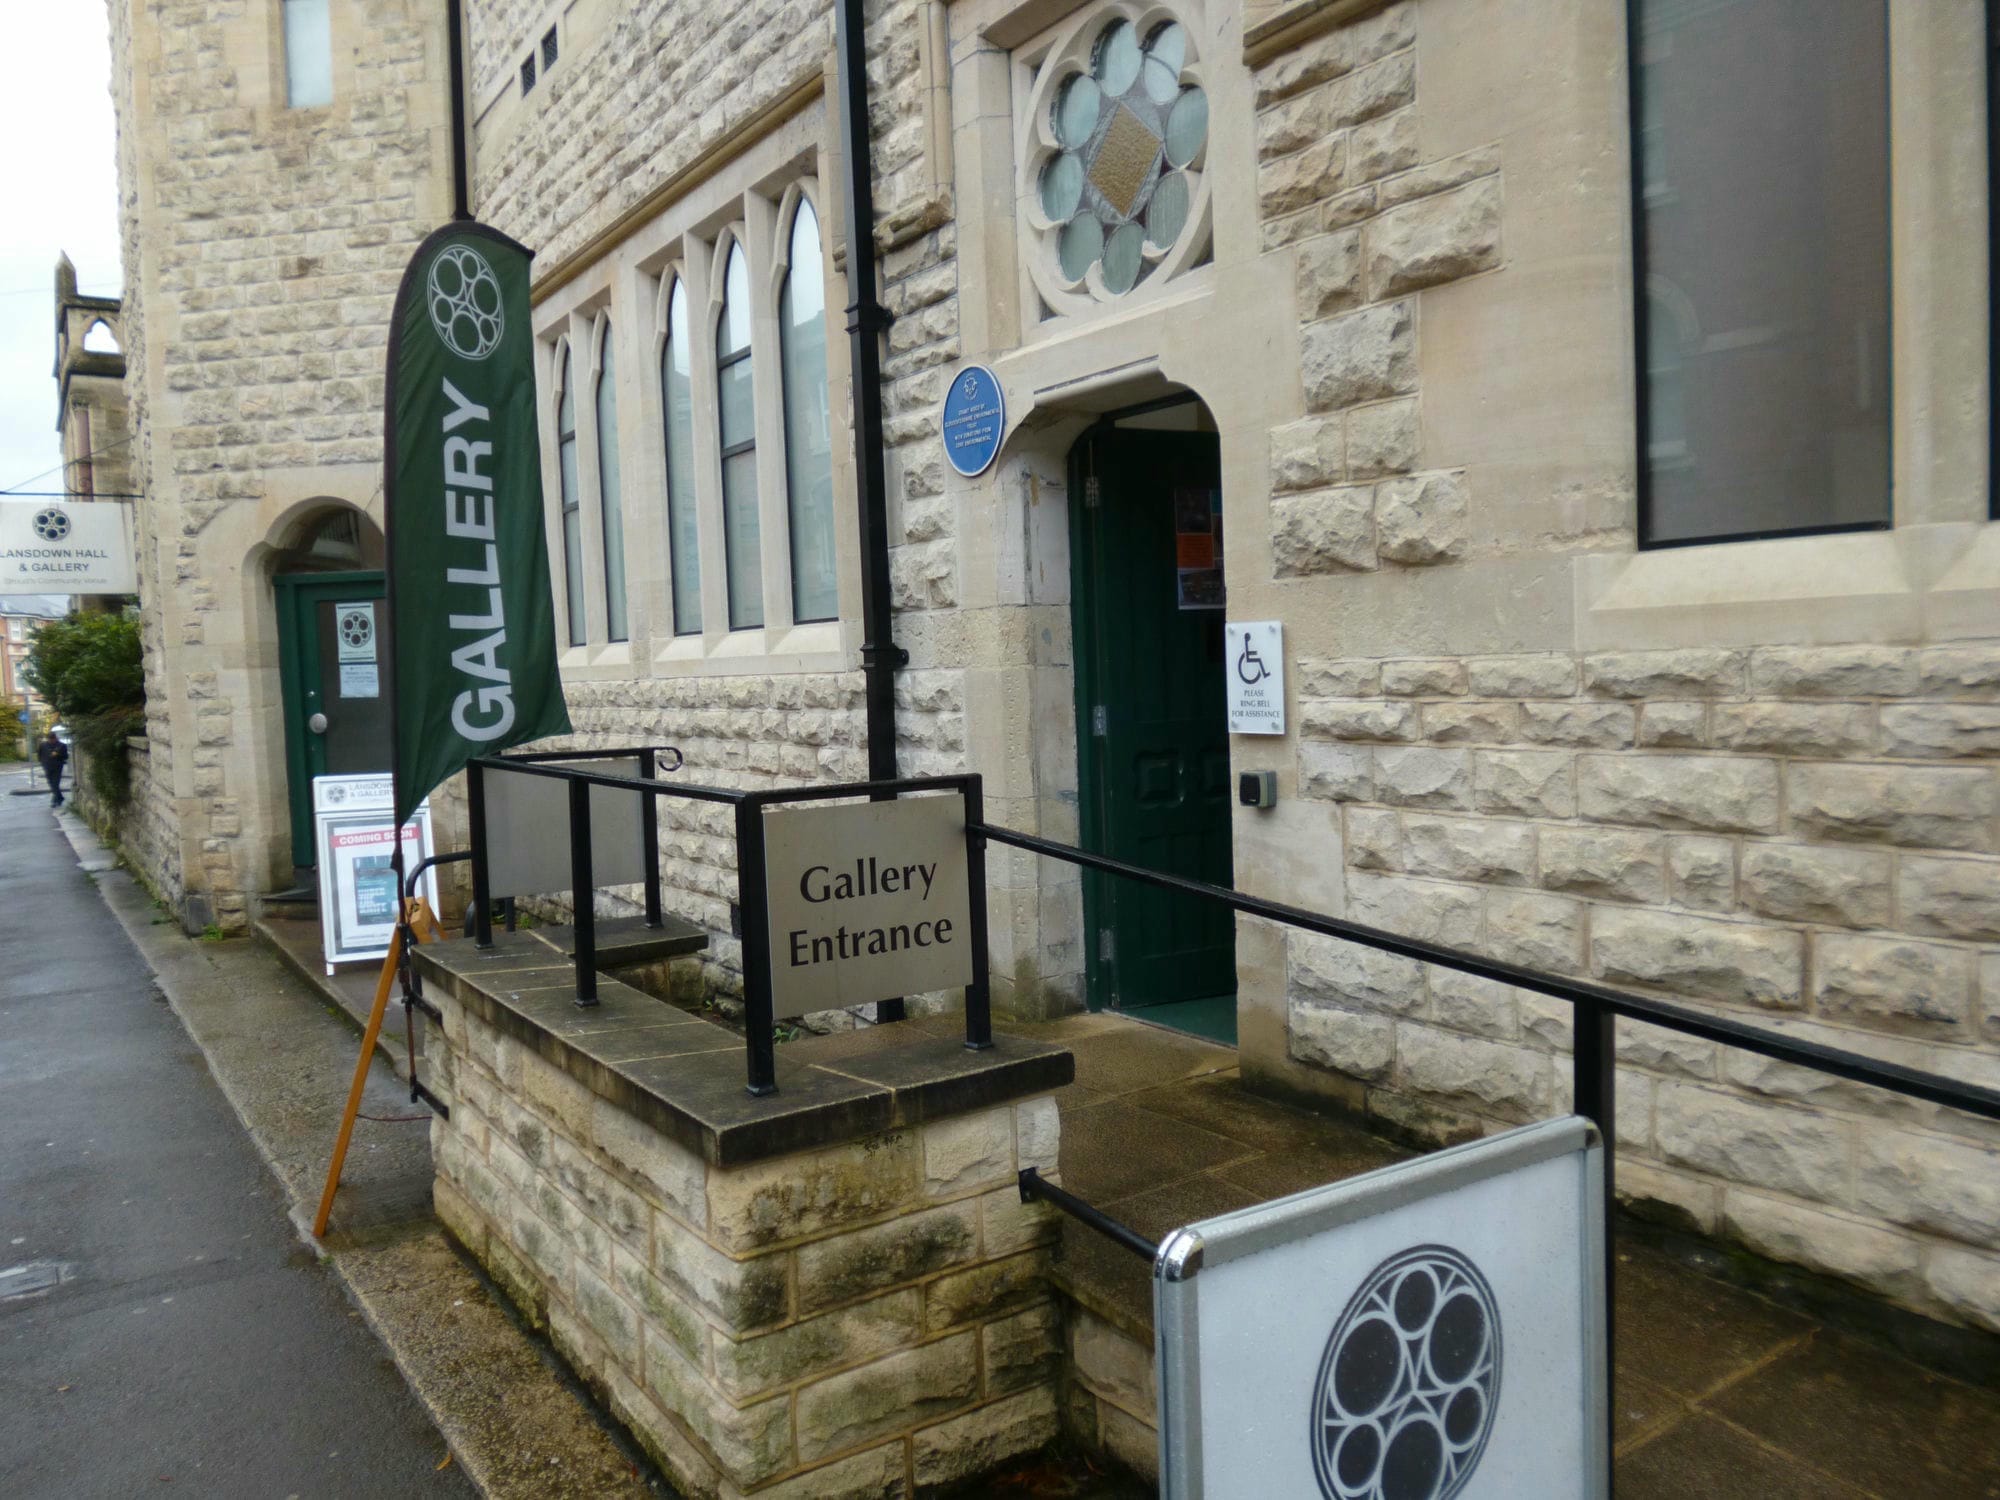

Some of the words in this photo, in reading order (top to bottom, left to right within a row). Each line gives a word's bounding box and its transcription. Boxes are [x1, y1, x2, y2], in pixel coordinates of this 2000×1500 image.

[76, 549, 108, 558] HALL
[442, 376, 515, 741] GALLERY
[19, 563, 28, 572] &
[32, 563, 89, 572] GALLERY
[1244, 689, 1264, 697] PLEASE
[1257, 700, 1270, 708] BELL
[1232, 710, 1243, 718] FOR
[1245, 710, 1280, 718] ASSISTANCE
[340, 832, 382, 845] COMING
[799, 856, 937, 904] Gallery
[789, 917, 953, 967] Entrance
